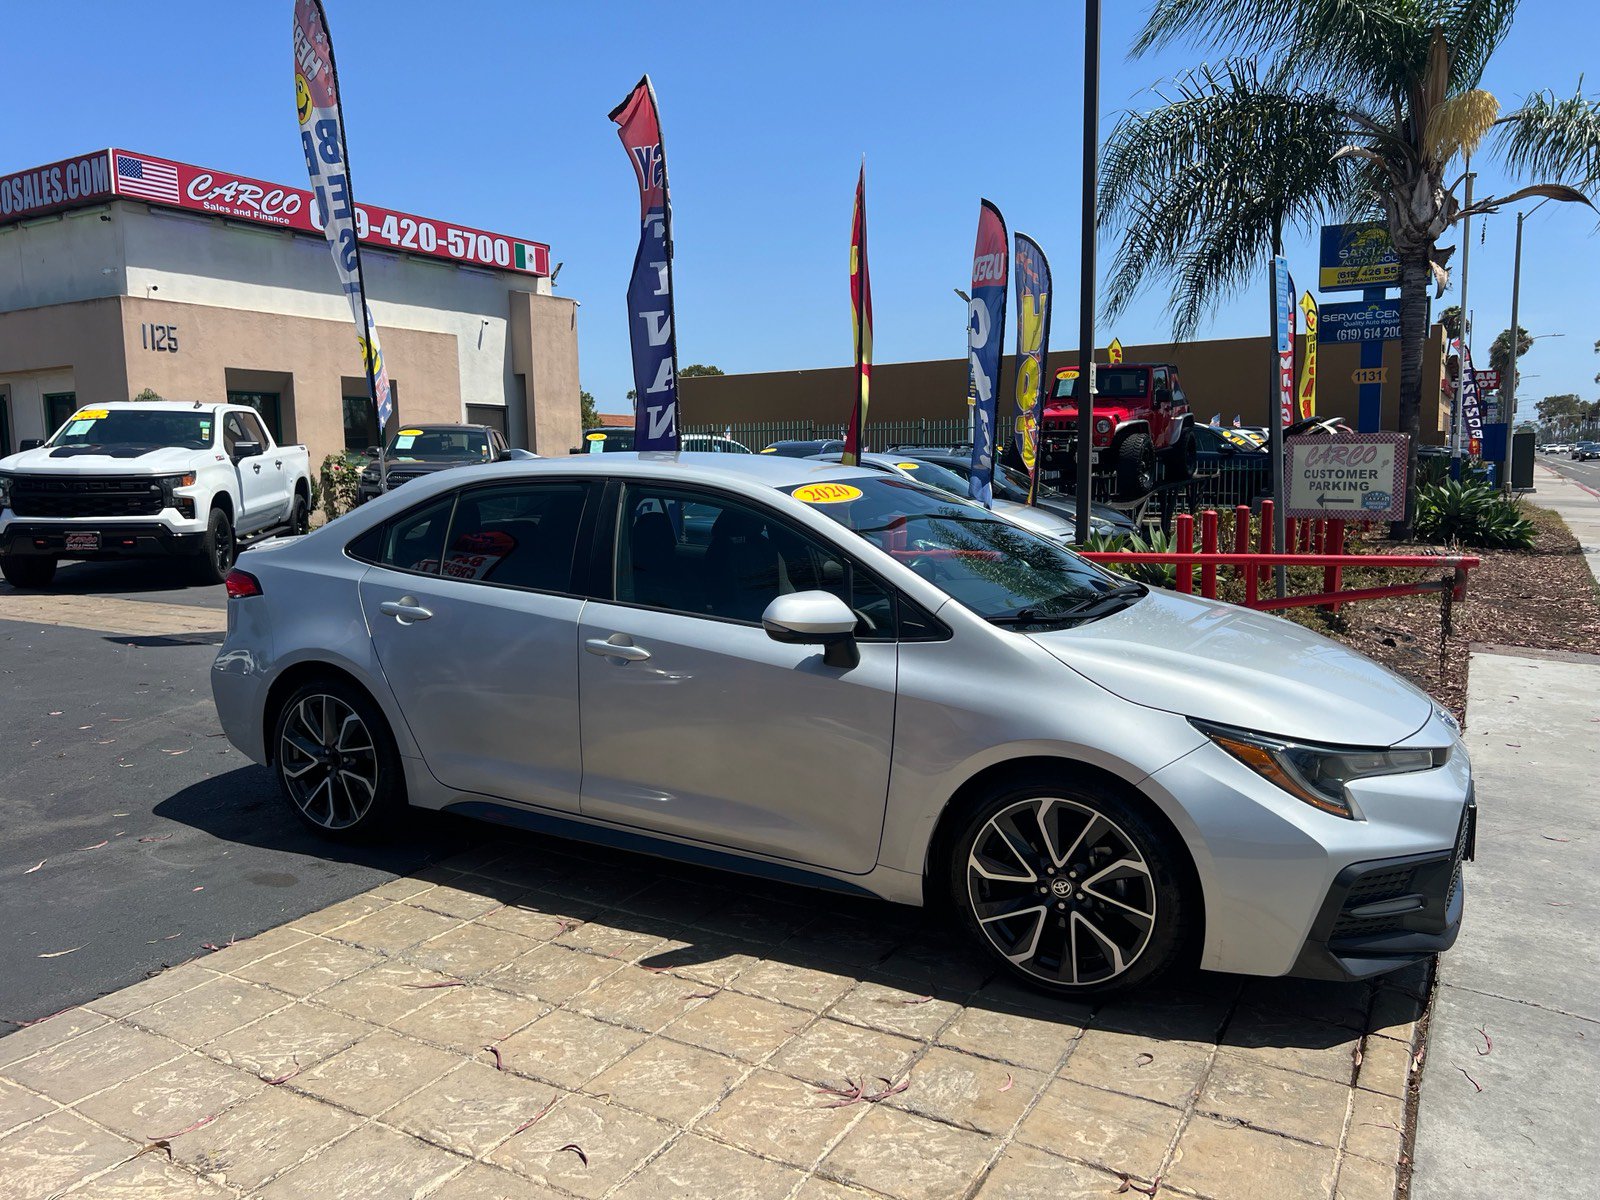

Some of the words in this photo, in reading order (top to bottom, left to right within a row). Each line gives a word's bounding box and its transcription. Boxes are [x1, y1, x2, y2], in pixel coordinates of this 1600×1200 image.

[0, 155, 110, 216] OSALES.COM
[186, 174, 301, 215] CARCO
[203, 201, 230, 213] Sales
[233, 207, 250, 217] and
[253, 211, 290, 225] Finance
[309, 198, 510, 267] 69-420-5700
[1322, 311, 1373, 323] SERVICE
[1375, 309, 1400, 319] CEN
[142, 323, 178, 353] 1125
[1336, 328, 1361, 341] (619)
[1364, 327, 1381, 339] 614
[1354, 370, 1382, 382] 1131
[1304, 444, 1378, 468] CARCO
[1304, 469, 1378, 480] CUSTOMER
[804, 484, 850, 501] 2020
[1309, 481, 1370, 491] PARKING
